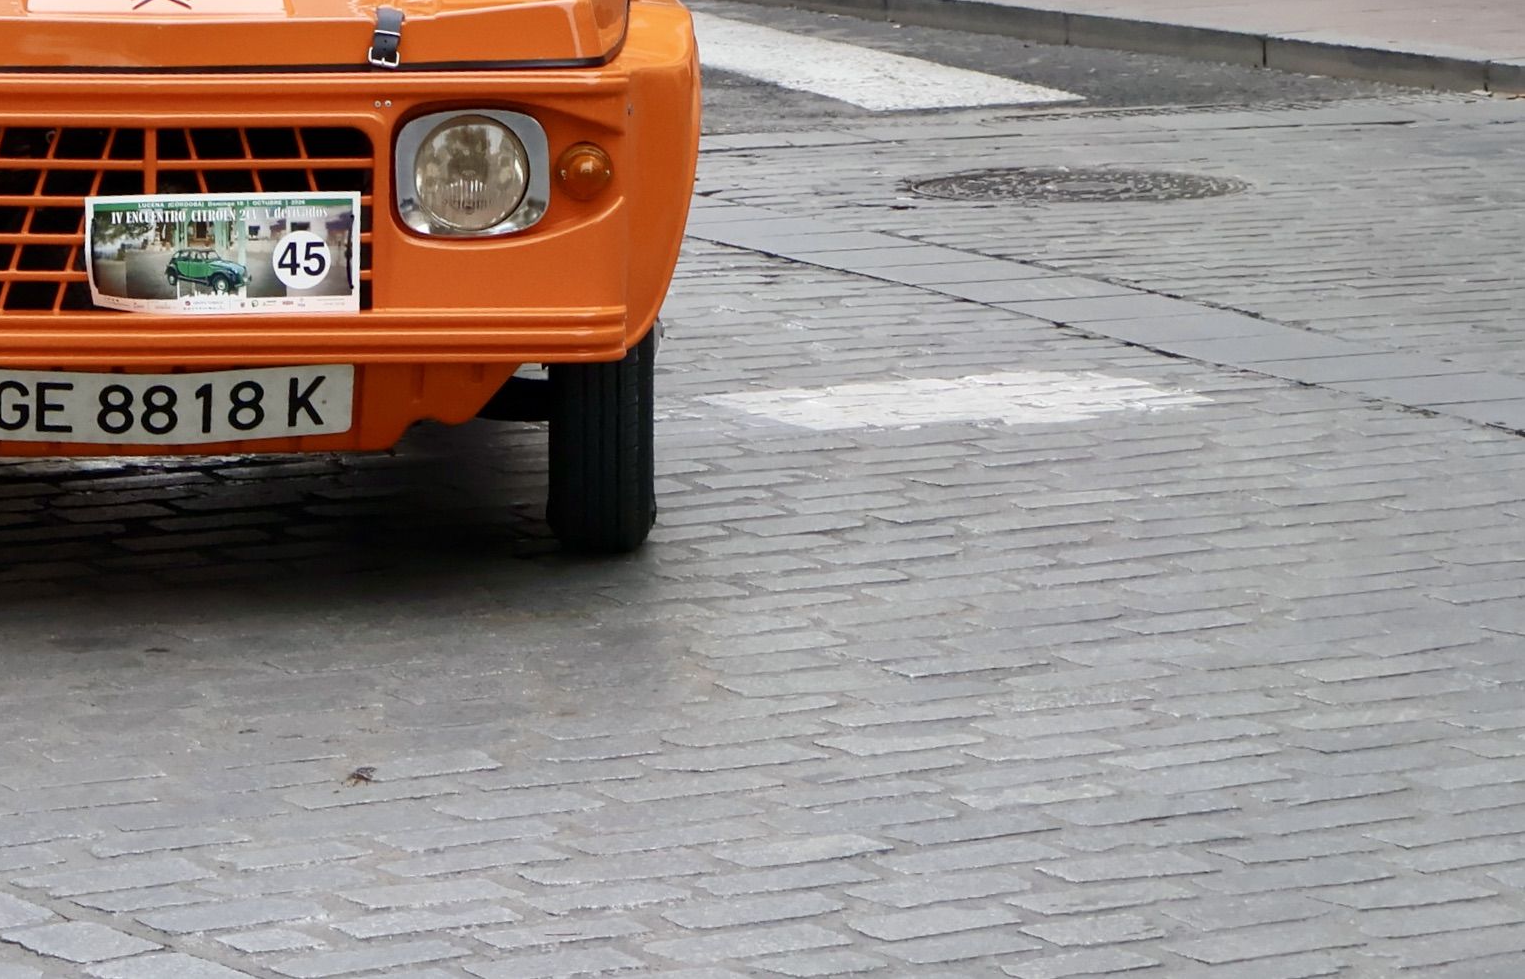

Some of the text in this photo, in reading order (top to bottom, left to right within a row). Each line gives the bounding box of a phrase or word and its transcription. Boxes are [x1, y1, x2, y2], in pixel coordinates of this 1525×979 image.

[111, 211, 123, 225] IV
[126, 209, 186, 224] ENCUENTRO
[278, 241, 326, 277] 45
[97, 380, 264, 434] 8818
[288, 375, 325, 427] K
